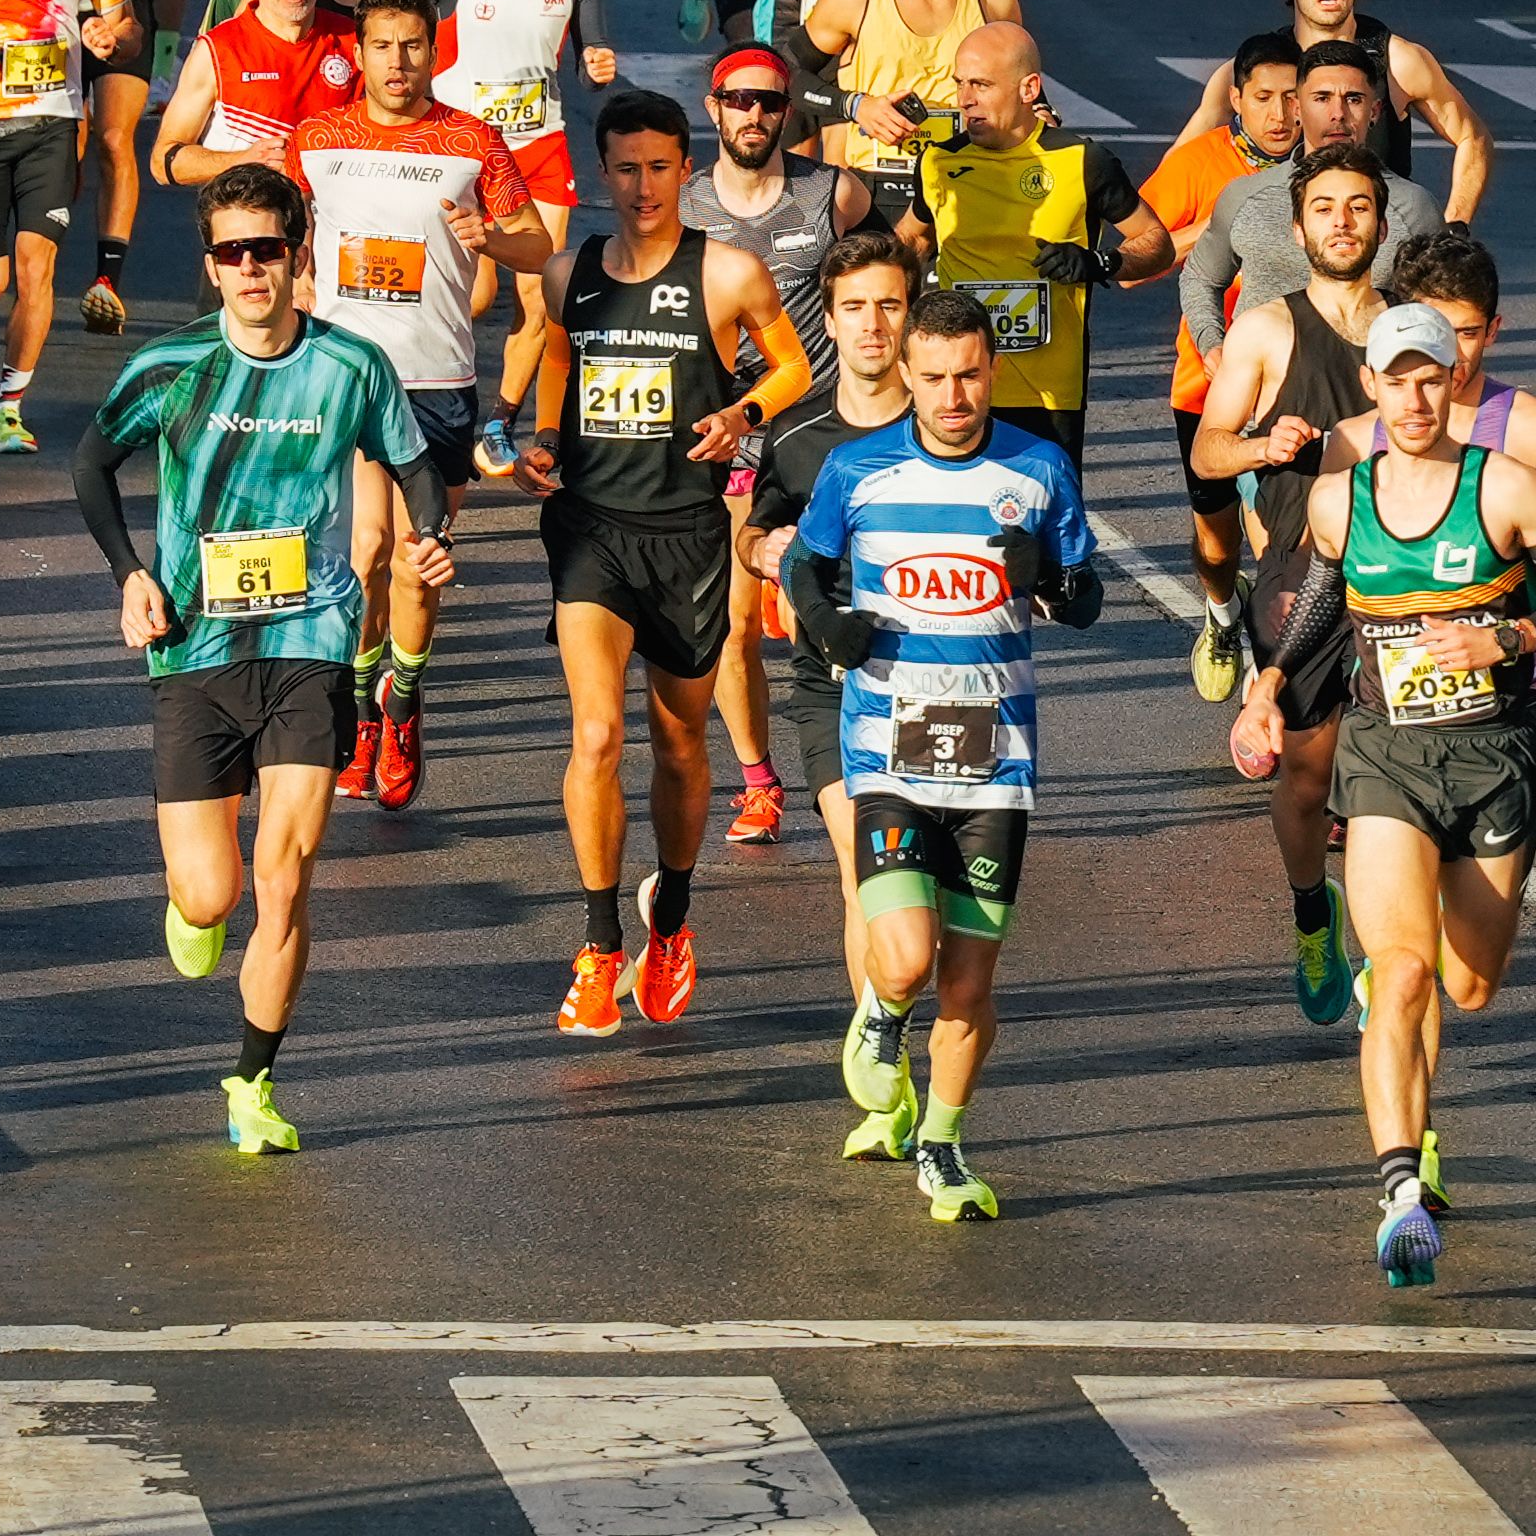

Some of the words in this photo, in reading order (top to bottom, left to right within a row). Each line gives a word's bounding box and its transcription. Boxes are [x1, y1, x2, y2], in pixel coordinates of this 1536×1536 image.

[21, 65, 56, 82] 137
[483, 105, 534, 122] 2078
[347, 161, 444, 184] ULTRANNER
[362, 253, 398, 266] RICARD
[353, 264, 405, 287] 252
[569, 329, 699, 352] TOP4RUNNING
[588, 386, 666, 414] 2119
[239, 557, 271, 570] SERGI
[237, 569, 271, 594] 61
[896, 566, 987, 602] DANI
[1399, 670, 1481, 702] 2034
[926, 723, 965, 737] JOSEP
[933, 736, 956, 760] 3
